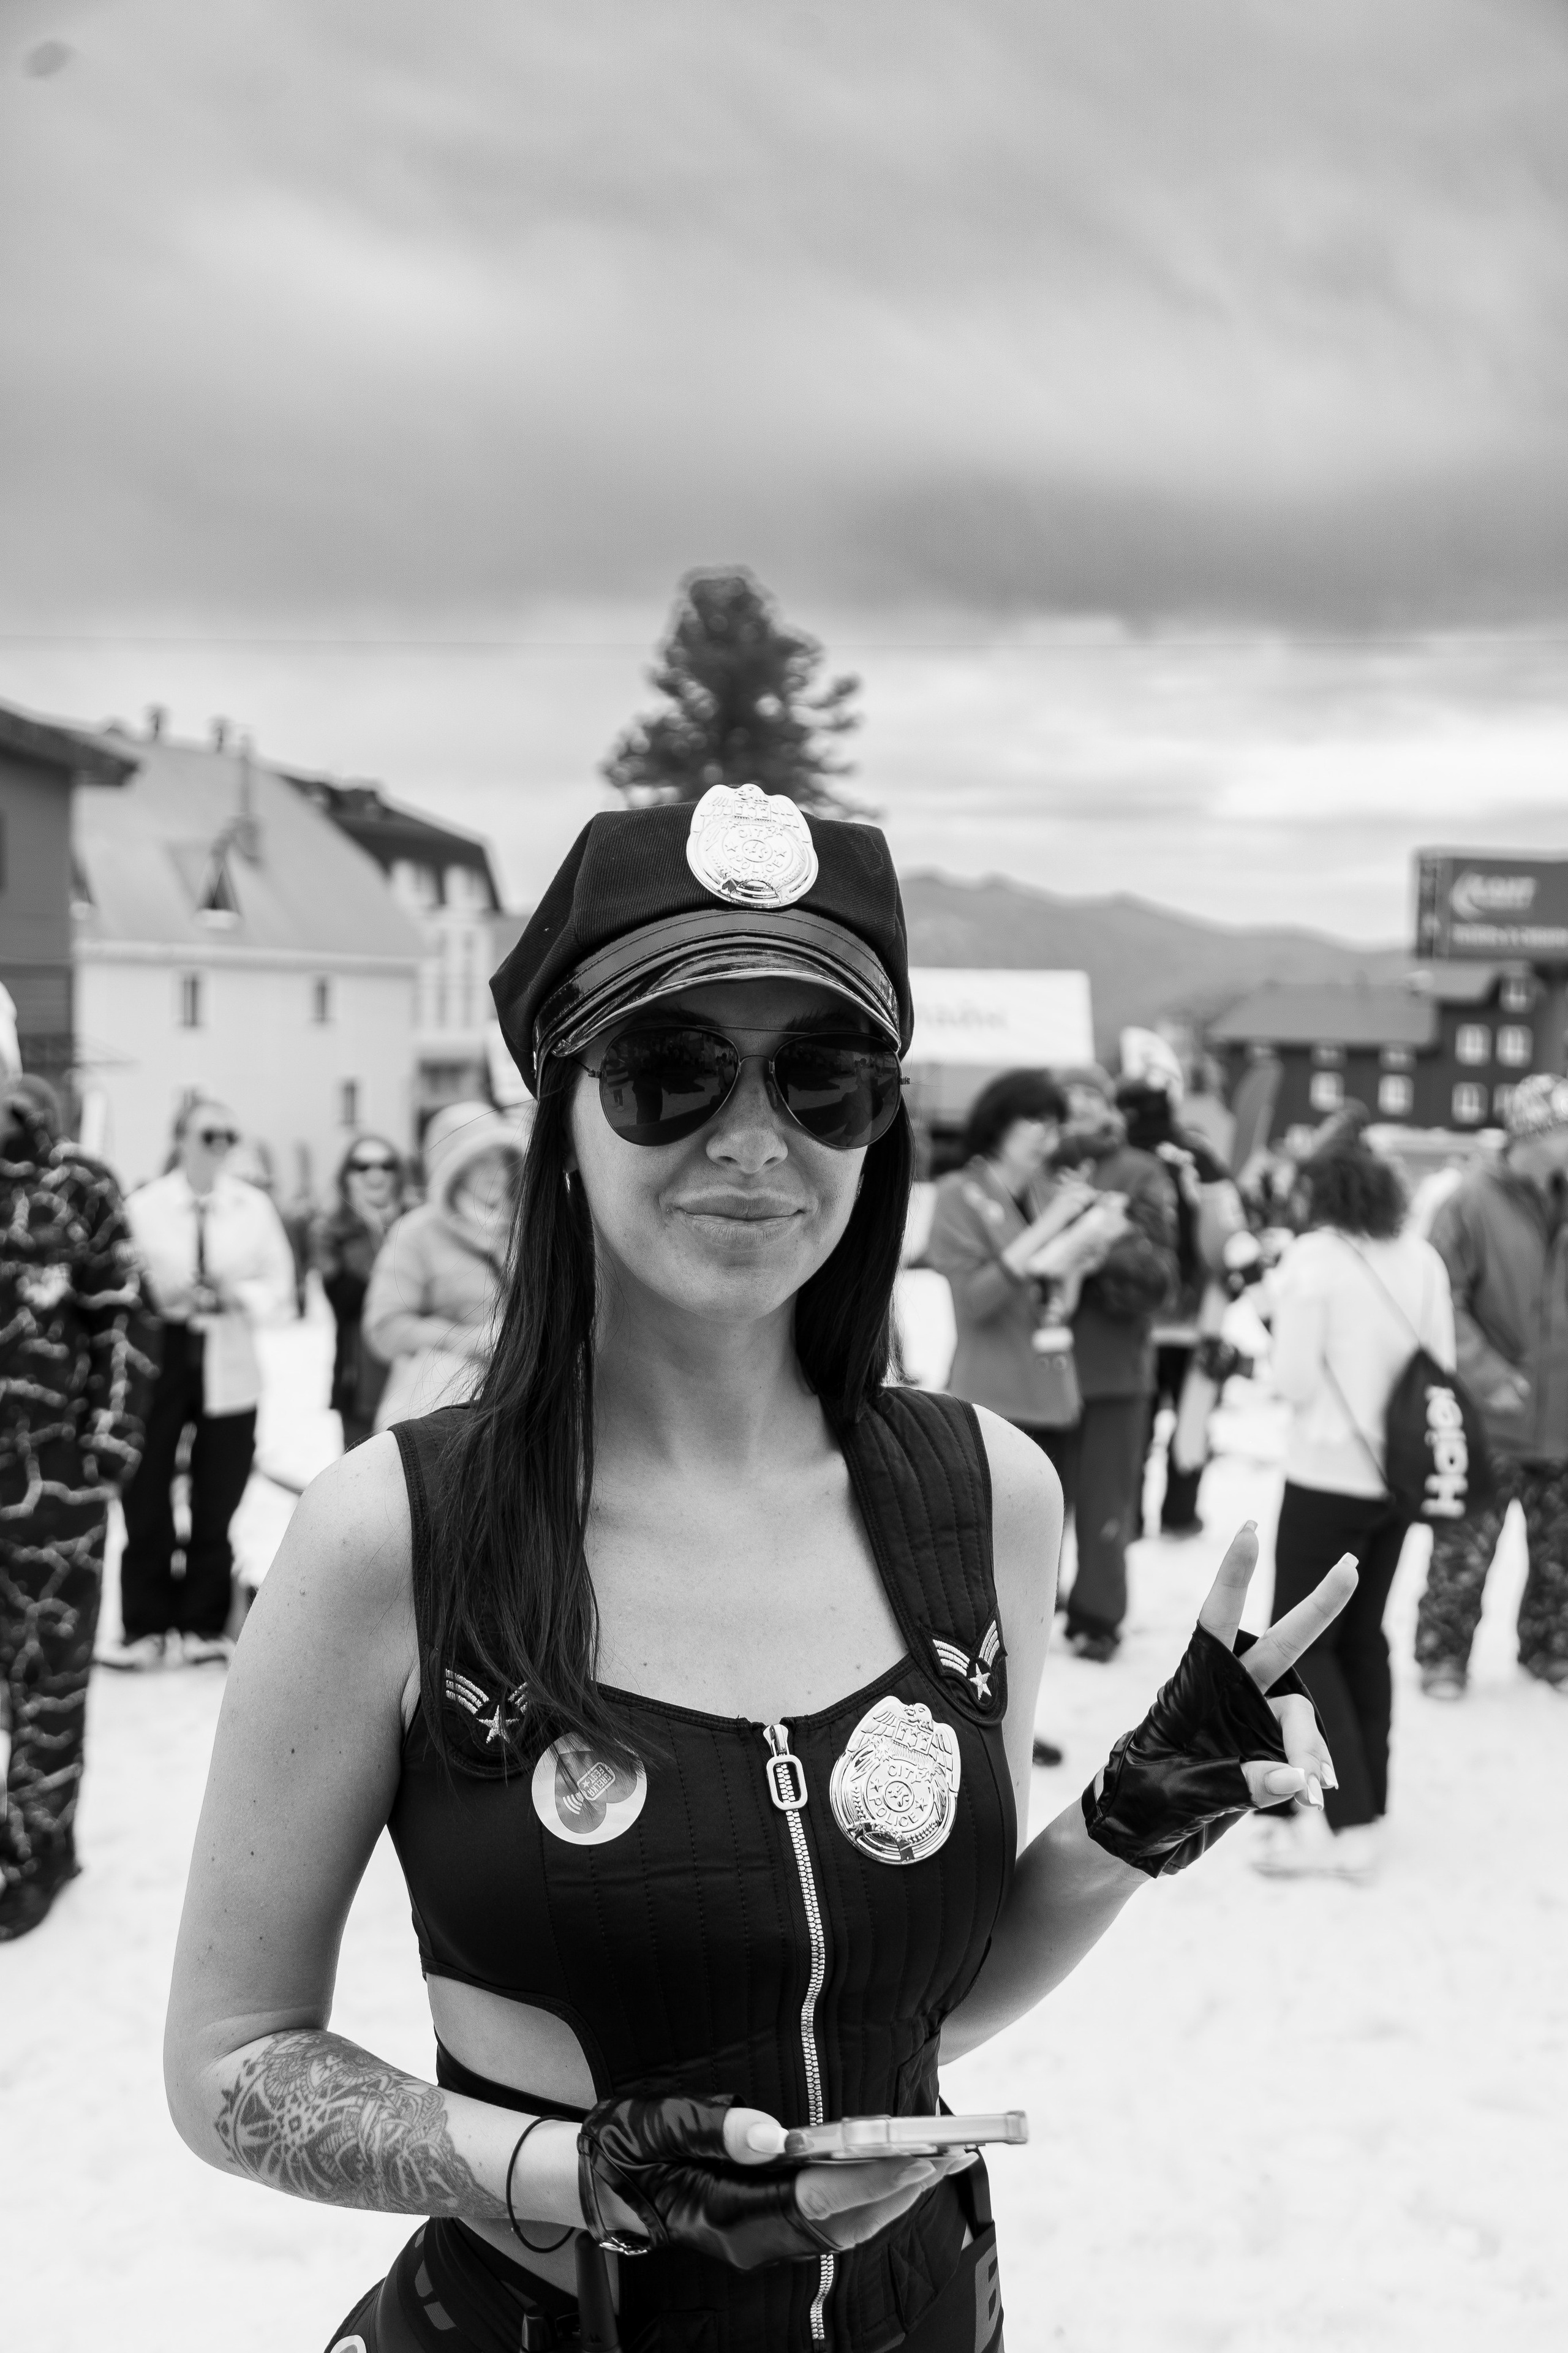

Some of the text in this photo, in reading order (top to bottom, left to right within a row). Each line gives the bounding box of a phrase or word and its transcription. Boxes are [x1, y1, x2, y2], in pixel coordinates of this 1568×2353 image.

[739, 829, 776, 839] CITY
[731, 855, 783, 873] POLICE
[1422, 1386, 1469, 1517] Haier
[587, 1766, 605, 1784] FEST
[888, 1765, 927, 1784] CITY
[869, 1798, 919, 1827] POLICE
